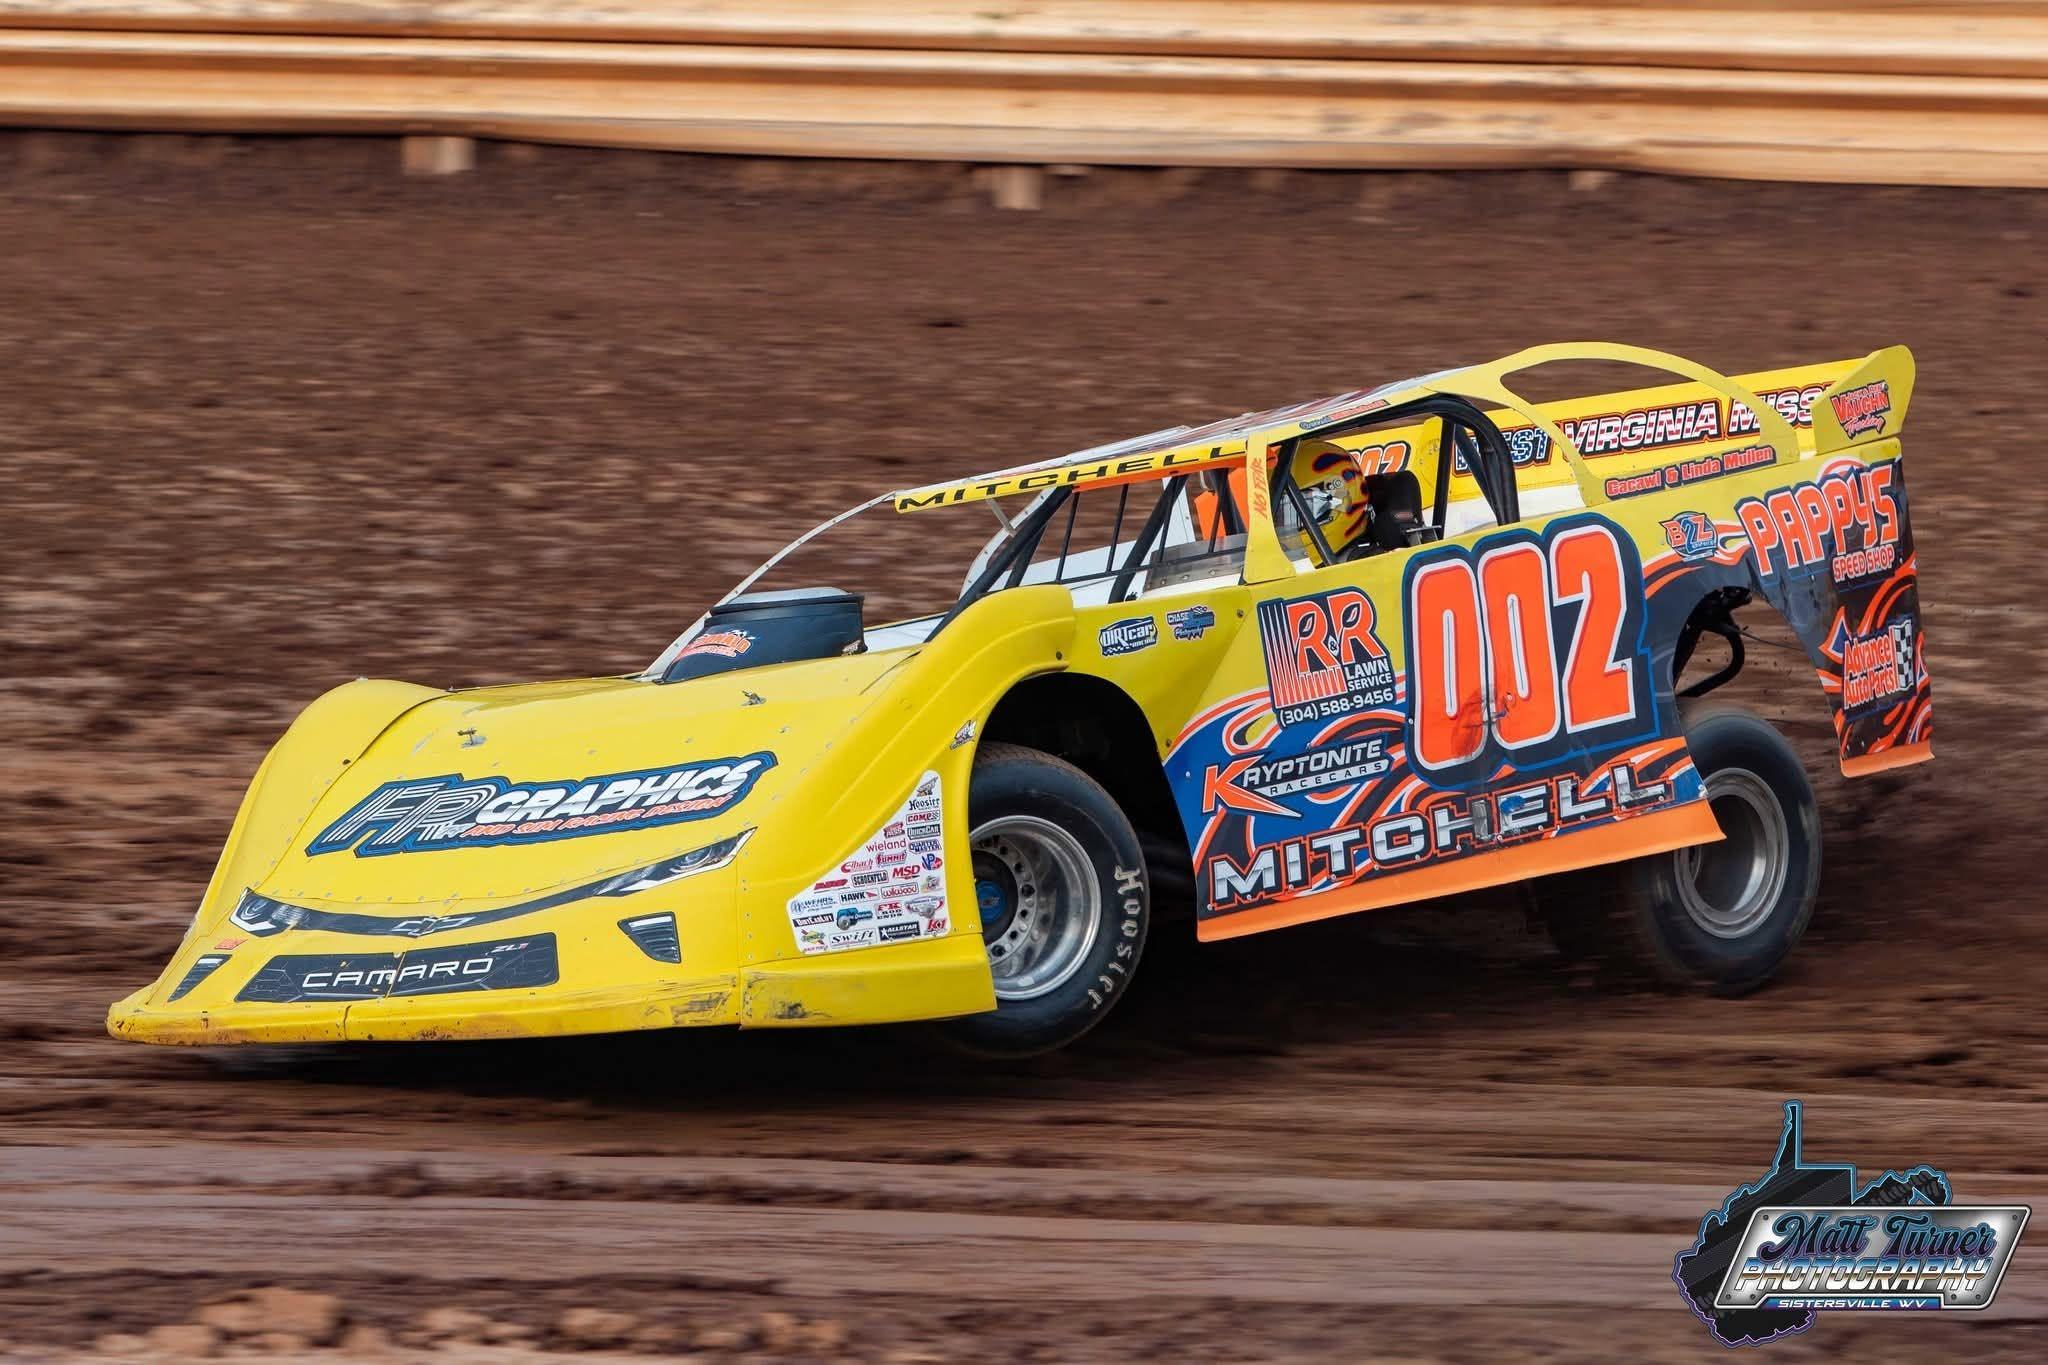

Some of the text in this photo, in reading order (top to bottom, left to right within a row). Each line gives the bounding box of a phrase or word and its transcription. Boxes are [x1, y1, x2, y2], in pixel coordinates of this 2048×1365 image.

[1831, 391, 1889, 422] VAUGHN
[1565, 402, 1718, 453] VIRGINIA
[899, 446, 1247, 510] MITCHELL
[1681, 458, 1721, 481] Linda
[1723, 446, 1774, 471] Mullen
[1737, 464, 1899, 577] PAPPYS
[1832, 545, 1895, 583] SPEED SHOP
[1101, 623, 1154, 647] DIRTcar
[1411, 524, 1637, 771] 002
[1345, 658, 1390, 680] LAWN
[1844, 634, 1893, 679] Advance
[1347, 672, 1393, 692] SERVICE
[1843, 668, 1897, 710] Auto Parts
[1280, 688, 1394, 727] (304) 588-9456
[476, 759, 763, 824] GRAPHICS
[1203, 739, 1383, 818] KRYPTONITE
[1270, 762, 1382, 796] RACECARS
[909, 797, 940, 811] Hoosier
[865, 838, 907, 853] wieland
[1214, 765, 1672, 902] MITCHELL
[892, 864, 921, 878] MSD
[840, 892, 866, 902] HAWK
[831, 929, 875, 944] Swift
[1088, 865, 1145, 1010] Hoosier
[302, 957, 494, 988] CAMARO
